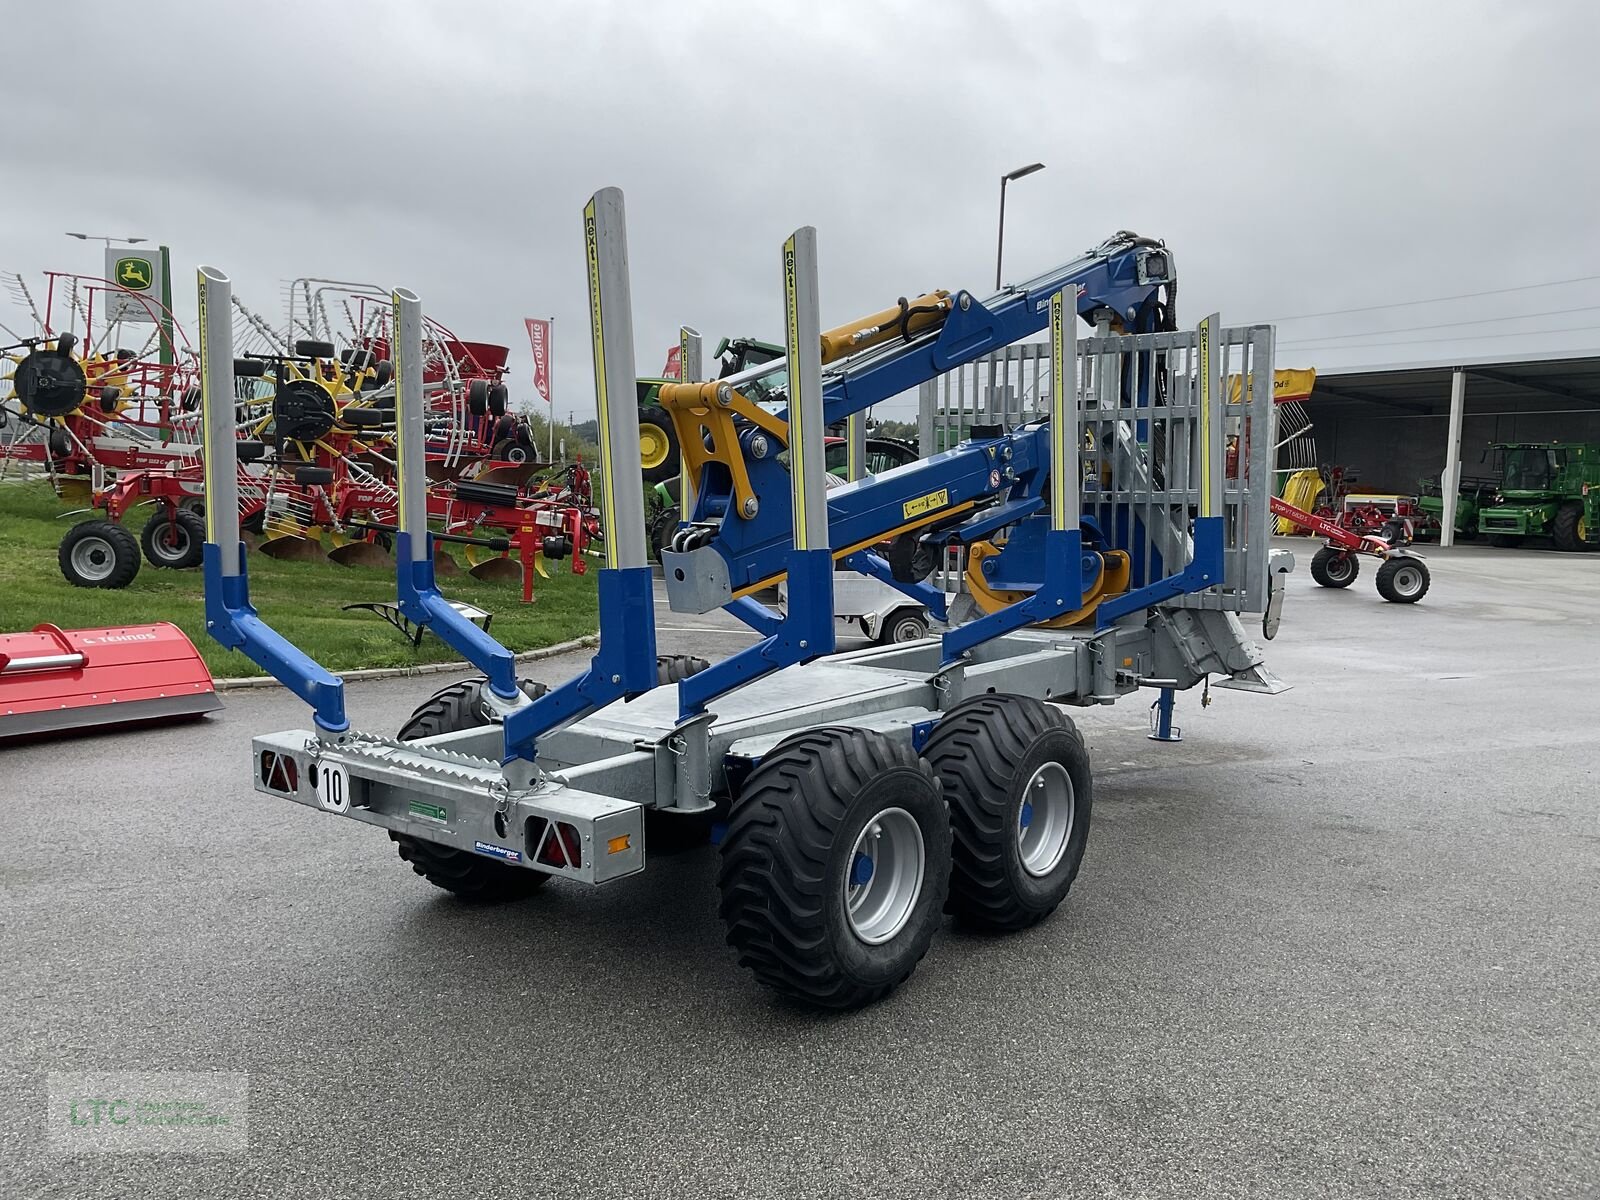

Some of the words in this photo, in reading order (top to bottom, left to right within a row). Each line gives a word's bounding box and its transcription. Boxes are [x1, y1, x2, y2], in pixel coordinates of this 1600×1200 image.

[587, 217, 596, 261] next
[786, 250, 794, 288] next
[1274, 503, 1286, 511] TOP
[1319, 522, 1331, 532] LTC
[98, 633, 157, 643] TEHNOS
[323, 767, 342, 806] 10
[475, 841, 519, 858] Binderberger
